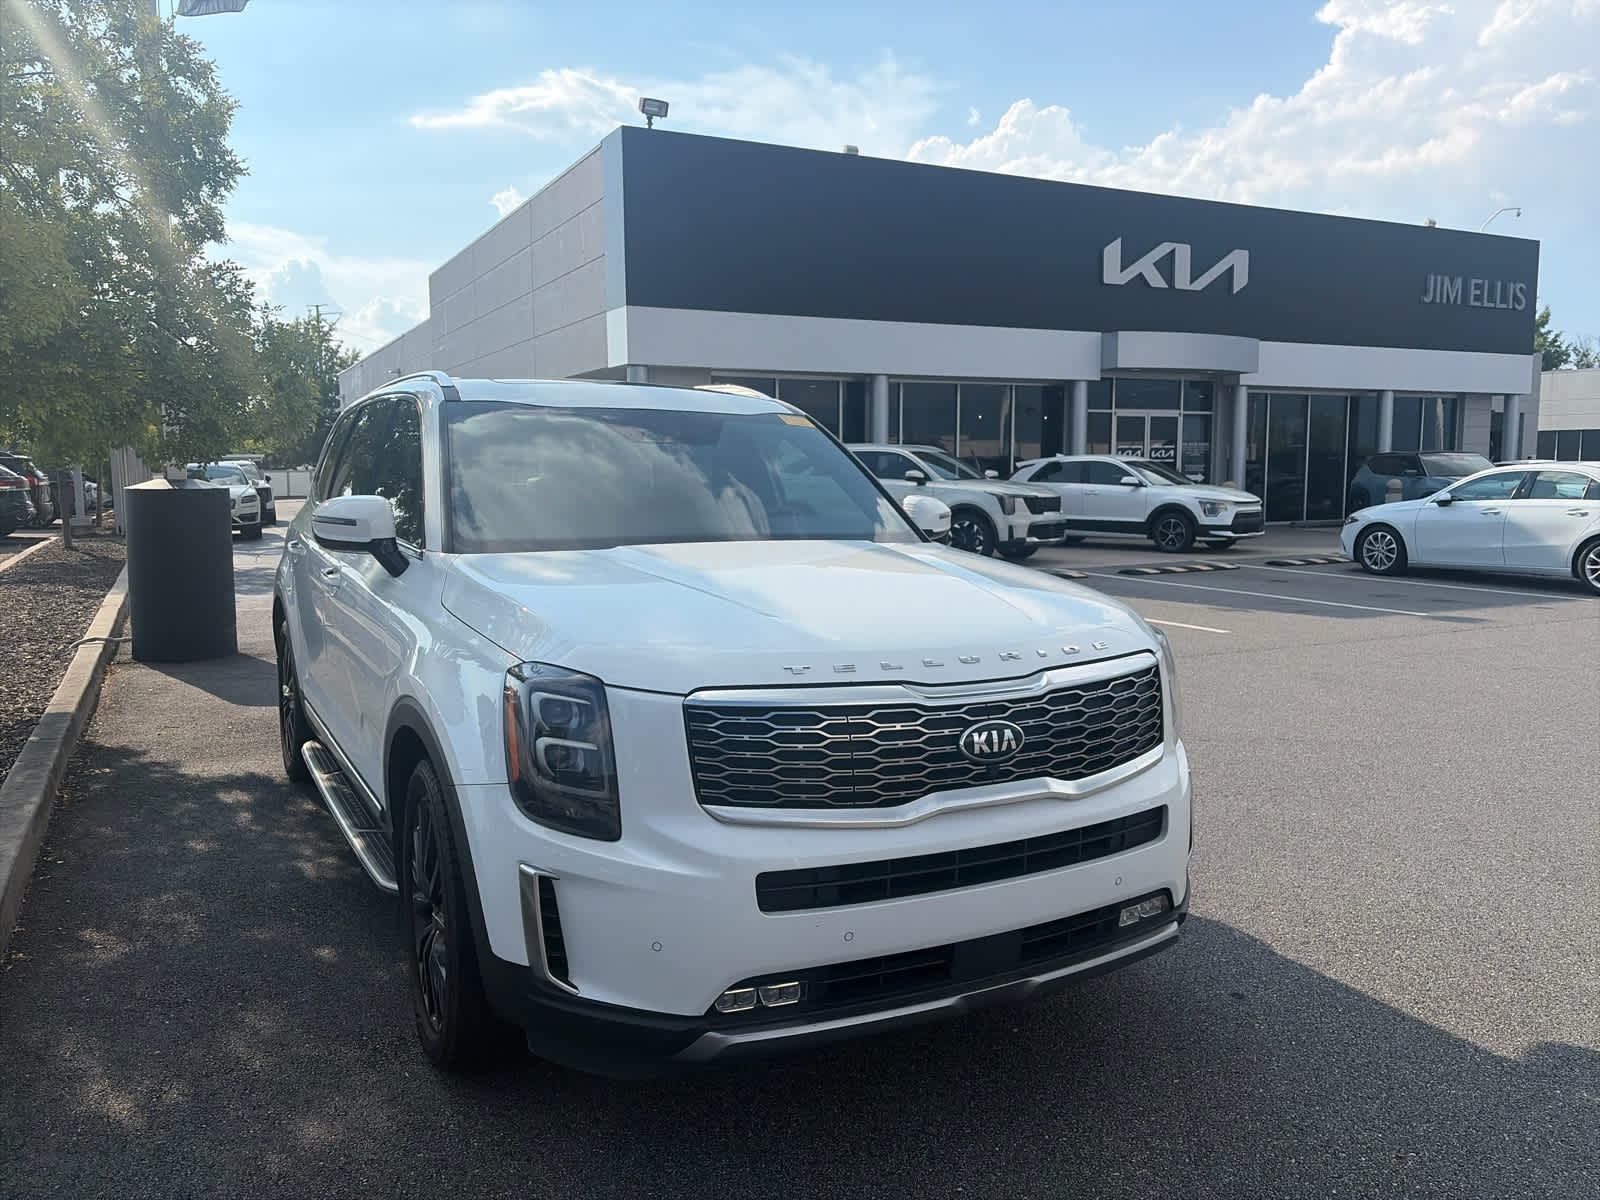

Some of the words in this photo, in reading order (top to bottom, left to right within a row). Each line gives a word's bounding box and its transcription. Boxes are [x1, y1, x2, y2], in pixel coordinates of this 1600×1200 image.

[1103, 236, 1249, 295] KIA
[1423, 273, 1463, 305] JIM
[1470, 278, 1527, 311] ELLIS
[783, 640, 1109, 676] TELLURIDE
[971, 728, 1017, 755] KIA
